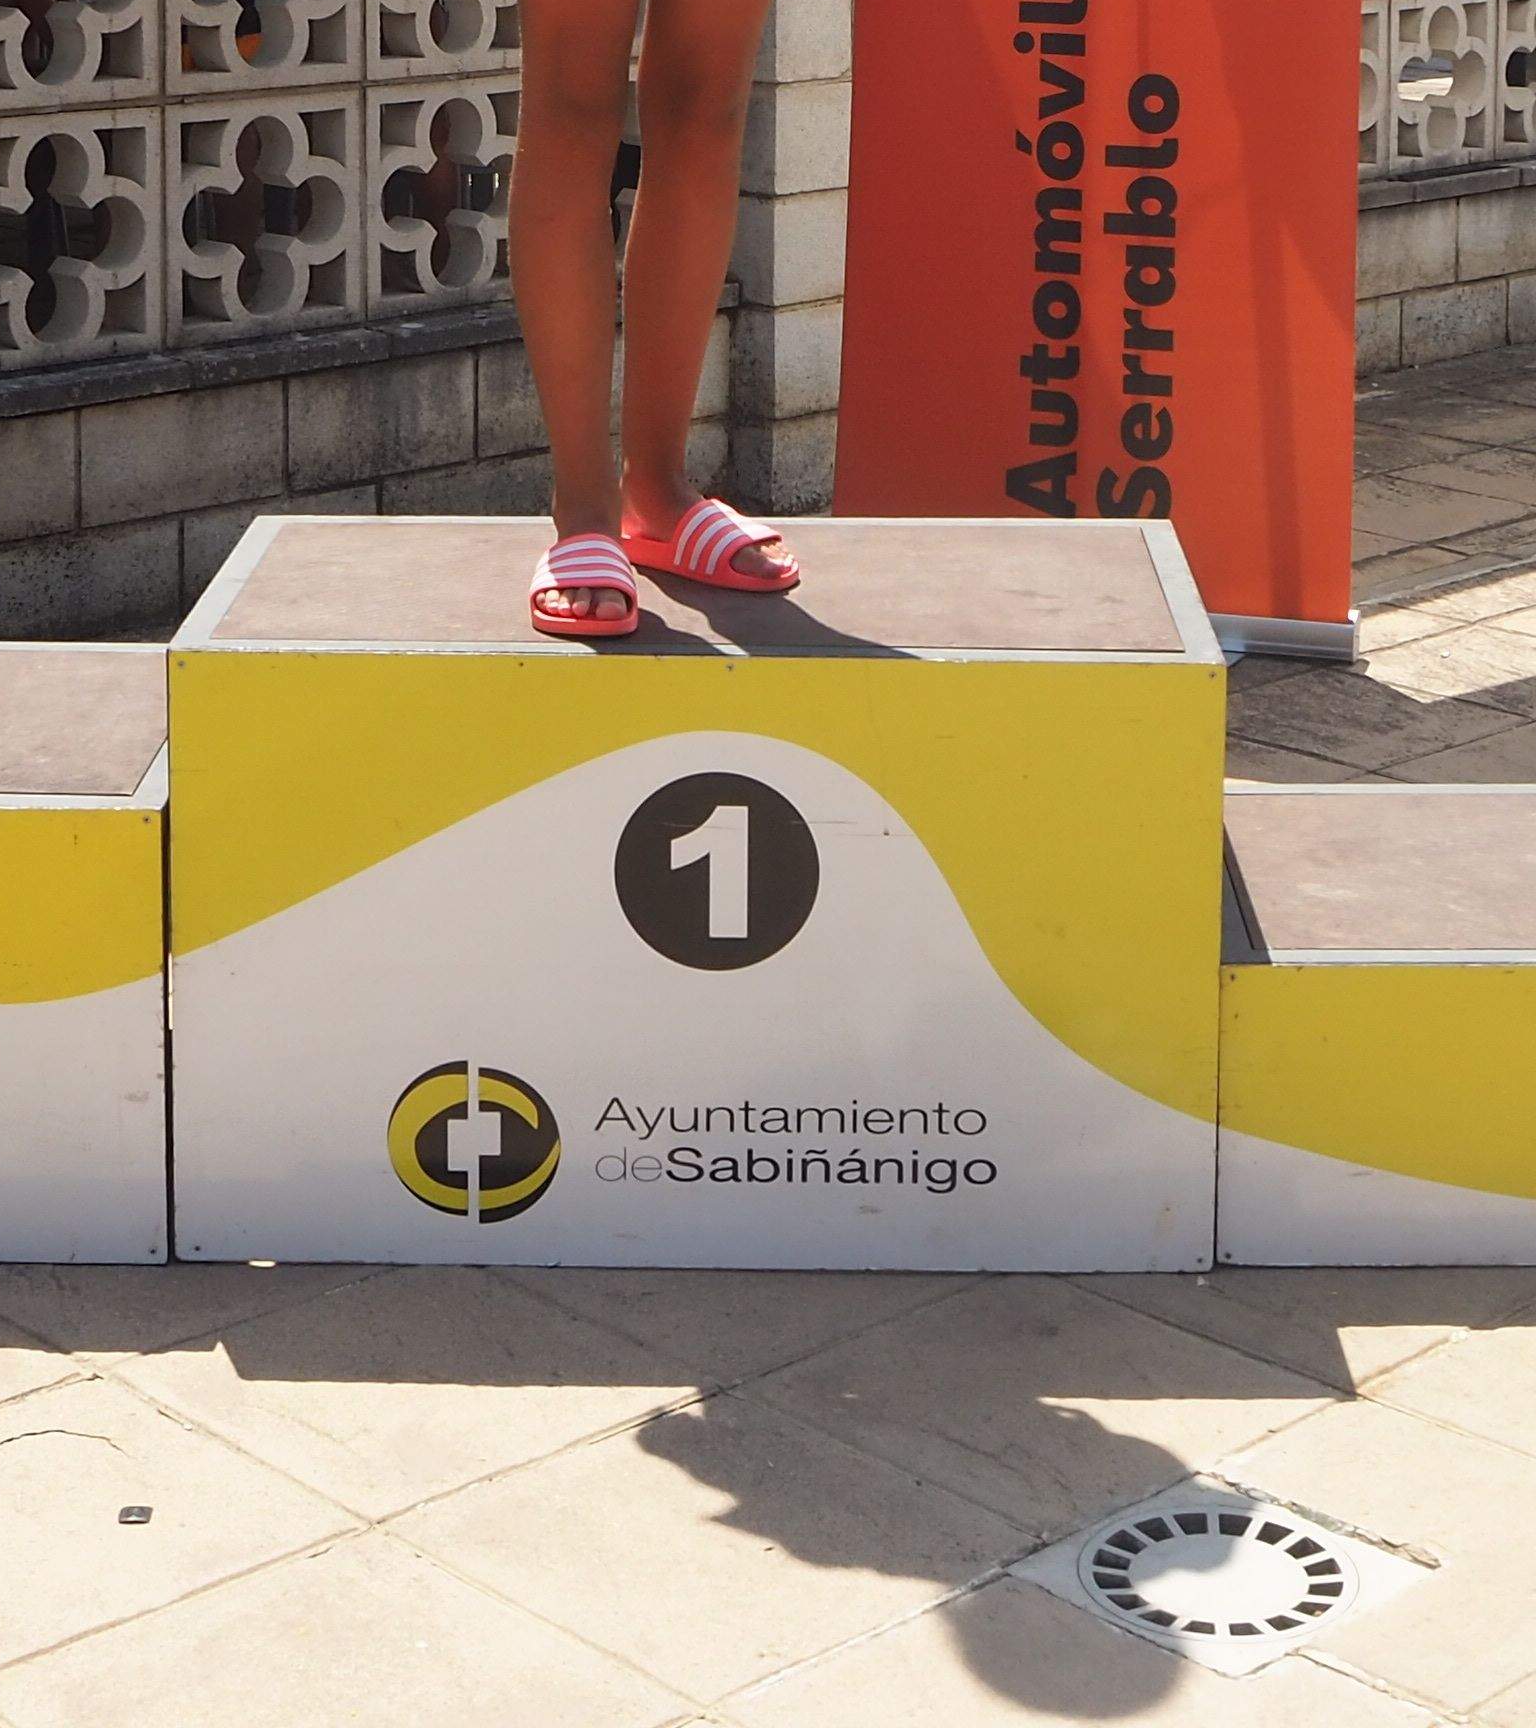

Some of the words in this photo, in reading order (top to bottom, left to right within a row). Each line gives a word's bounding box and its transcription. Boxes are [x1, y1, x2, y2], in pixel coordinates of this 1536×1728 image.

[1096, 73, 1181, 519] Serrablo
[670, 805, 749, 938] 1
[594, 1096, 988, 1143] Ayuntamiento
